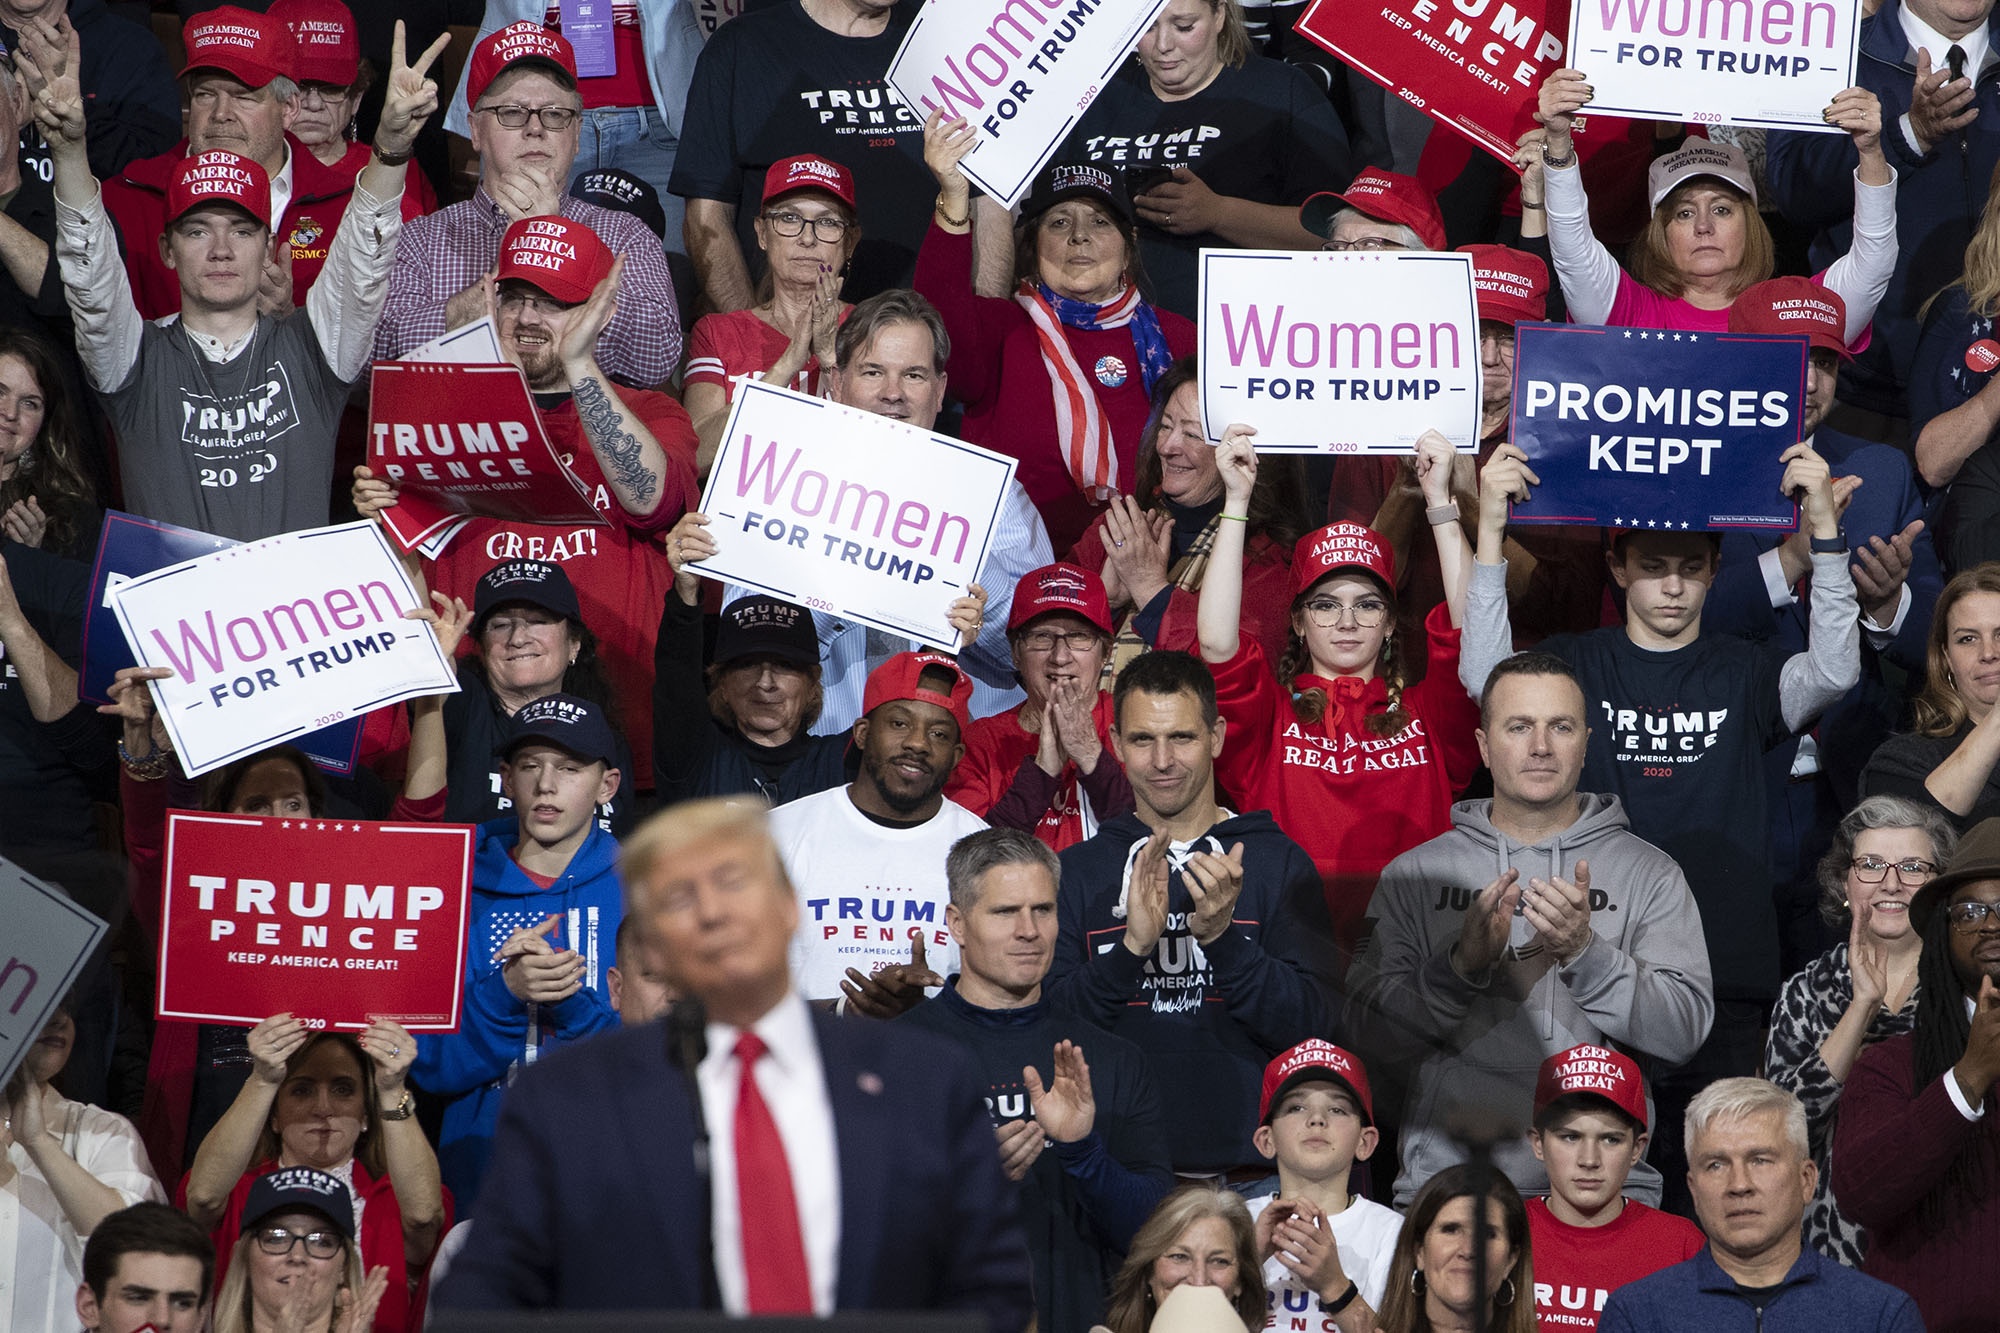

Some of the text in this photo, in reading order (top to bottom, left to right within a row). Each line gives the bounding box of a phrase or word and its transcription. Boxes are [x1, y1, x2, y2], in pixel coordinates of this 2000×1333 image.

[193, 25, 261, 40] MAKE AMERICA
[299, 21, 345, 33] AMERICA
[505, 22, 545, 37] KEEP
[195, 36, 254, 49] GREAT AGAIN
[310, 34, 341, 45] AGAIN
[492, 34, 561, 56] AMERICA
[1411, 0, 1537, 87] ENCE
[1380, 8, 1510, 95] KEEP AMERICA GREAT!
[1617, 43, 1811, 78] FOR TRUMP
[982, 0, 1101, 139] FOR TRUM
[801, 88, 904, 108] TRUM
[1076, 85, 1098, 111] 2020
[1399, 87, 1426, 109] 2020
[820, 108, 911, 124] PENC
[1692, 112, 1722, 122] 2020
[869, 138, 896, 147] 2020
[1086, 125, 1221, 152] TRUMP
[198, 151, 240, 166] KEEP
[1091, 144, 1202, 160] PENCE
[1663, 149, 1732, 168] MAKE AMERICA
[1668, 157, 1729, 173] GREAT AGAIN
[181, 166, 254, 187] AMERICA
[1051, 164, 1112, 186] Trump
[1074, 175, 1097, 184] 2020
[191, 180, 245, 196] GREAT
[584, 174, 643, 198] TRUMP
[584, 182, 636, 202] PENCE
[526, 220, 567, 238] KEEP
[508, 236, 576, 260] AMERICA
[513, 251, 564, 271] GREAT
[1474, 280, 1528, 298] REAT AGAIN
[1491, 270, 1533, 289] AMERICA
[1772, 299, 1838, 316] MAKE AMERICA
[1778, 310, 1837, 325] GREAT AGAIN
[1221, 303, 1460, 369] Women
[1248, 377, 1441, 401] FOR TRUMP
[1526, 380, 1790, 427] PROMISES
[373, 422, 530, 456] TRUMP
[1328, 442, 1358, 452] 2020
[1589, 434, 1722, 475] KEPT
[385, 458, 533, 481] PENCE
[737, 434, 970, 565] Women
[1326, 523, 1367, 538] KEEP
[486, 528, 598, 562] GREAT!
[742, 511, 935, 585] FOR TRUMP
[1311, 537, 1382, 557] AMERICA
[1321, 550, 1374, 566] GREAT
[485, 563, 552, 582] TRUMP
[490, 571, 546, 586] PENCE
[732, 605, 799, 620] TRUMP
[805, 597, 834, 613] 2020
[738, 614, 795, 626] PENCE
[150, 580, 403, 684] Women
[210, 631, 397, 709] FOR TRUMP
[521, 701, 587, 716] TRUMP
[523, 709, 579, 722] PENCE
[314, 711, 344, 728] 2020
[1611, 732, 1718, 750] ENCE
[1283, 746, 1357, 774] REAT
[1634, 754, 1674, 763] AMERICA
[1643, 767, 1672, 777] 2020
[189, 875, 444, 921] TRUMP
[807, 898, 947, 926] TRUM
[210, 919, 418, 951] PENCE
[838, 946, 861, 954] KEEP
[227, 951, 399, 970] KEEP AMERICA GREAT!
[1294, 1038, 1336, 1055] KEEP
[1568, 1045, 1610, 1061] KEEP
[1278, 1050, 1351, 1075] AMERICA
[1552, 1060, 1625, 1080] AMERICA
[1561, 1075, 1615, 1091] GREAT
[267, 1169, 340, 1188] TRUMP
[1544, 1313, 1595, 1327] AMERICA
